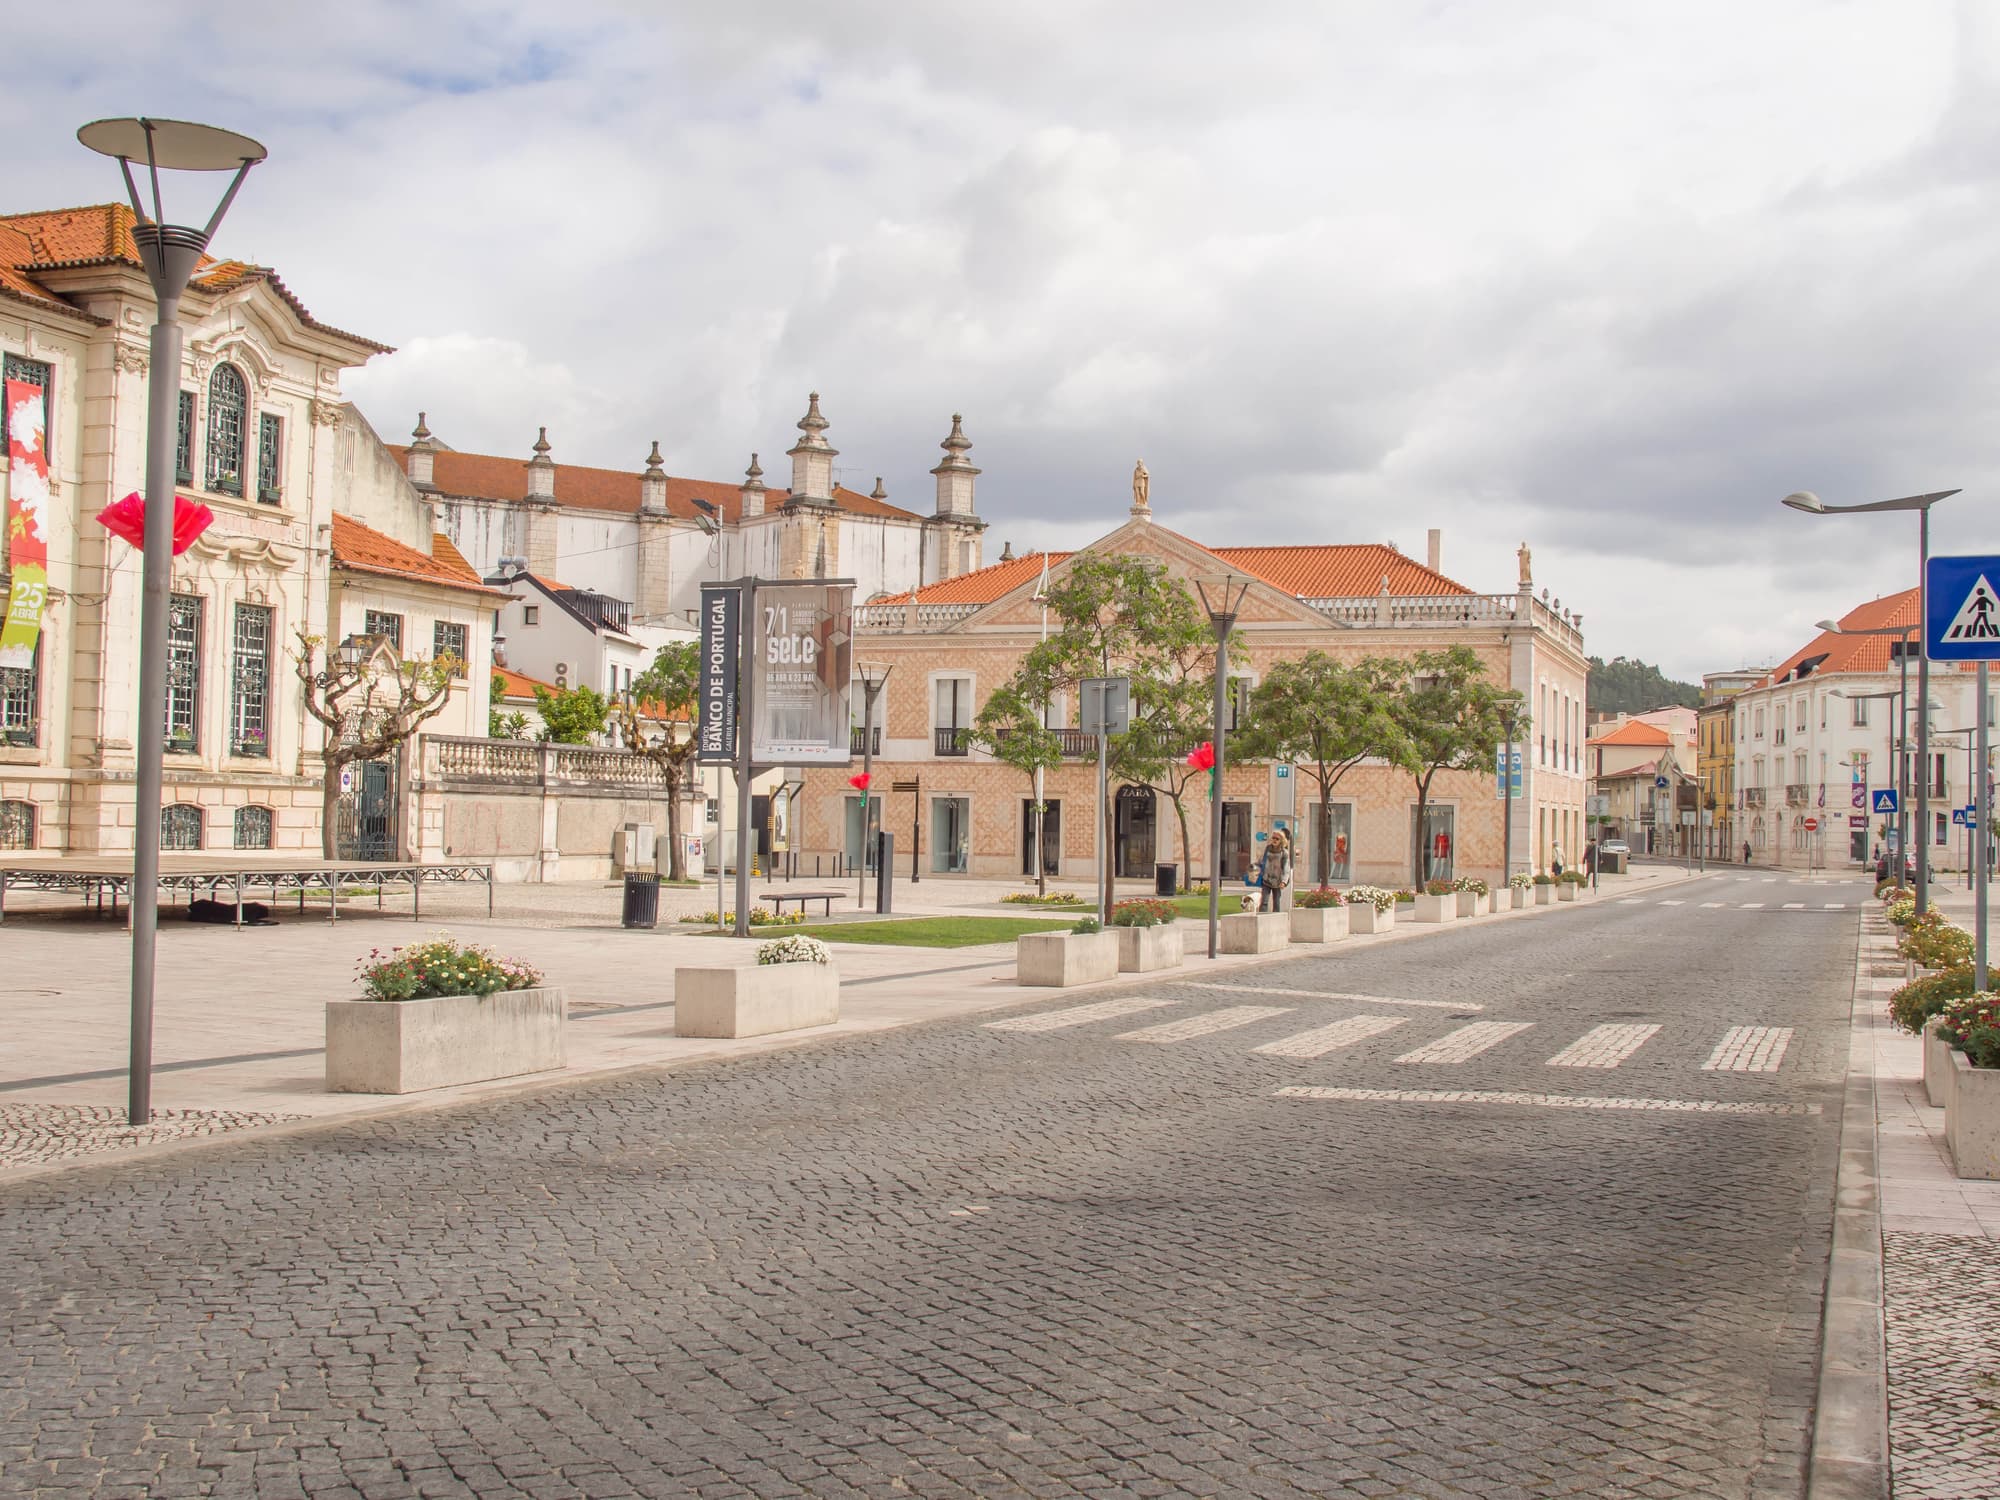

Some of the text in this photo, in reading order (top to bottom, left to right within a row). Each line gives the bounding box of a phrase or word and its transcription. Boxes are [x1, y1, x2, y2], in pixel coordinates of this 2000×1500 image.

[13, 582, 44, 609] 25
[10, 607, 40, 620] ABRIL
[767, 633, 815, 664] sete
[709, 597, 727, 752] BANCO DE PORTUGAL
[725, 692, 735, 751] GALERIA MUNICIPAL
[1122, 788, 1150, 797] ZARA
